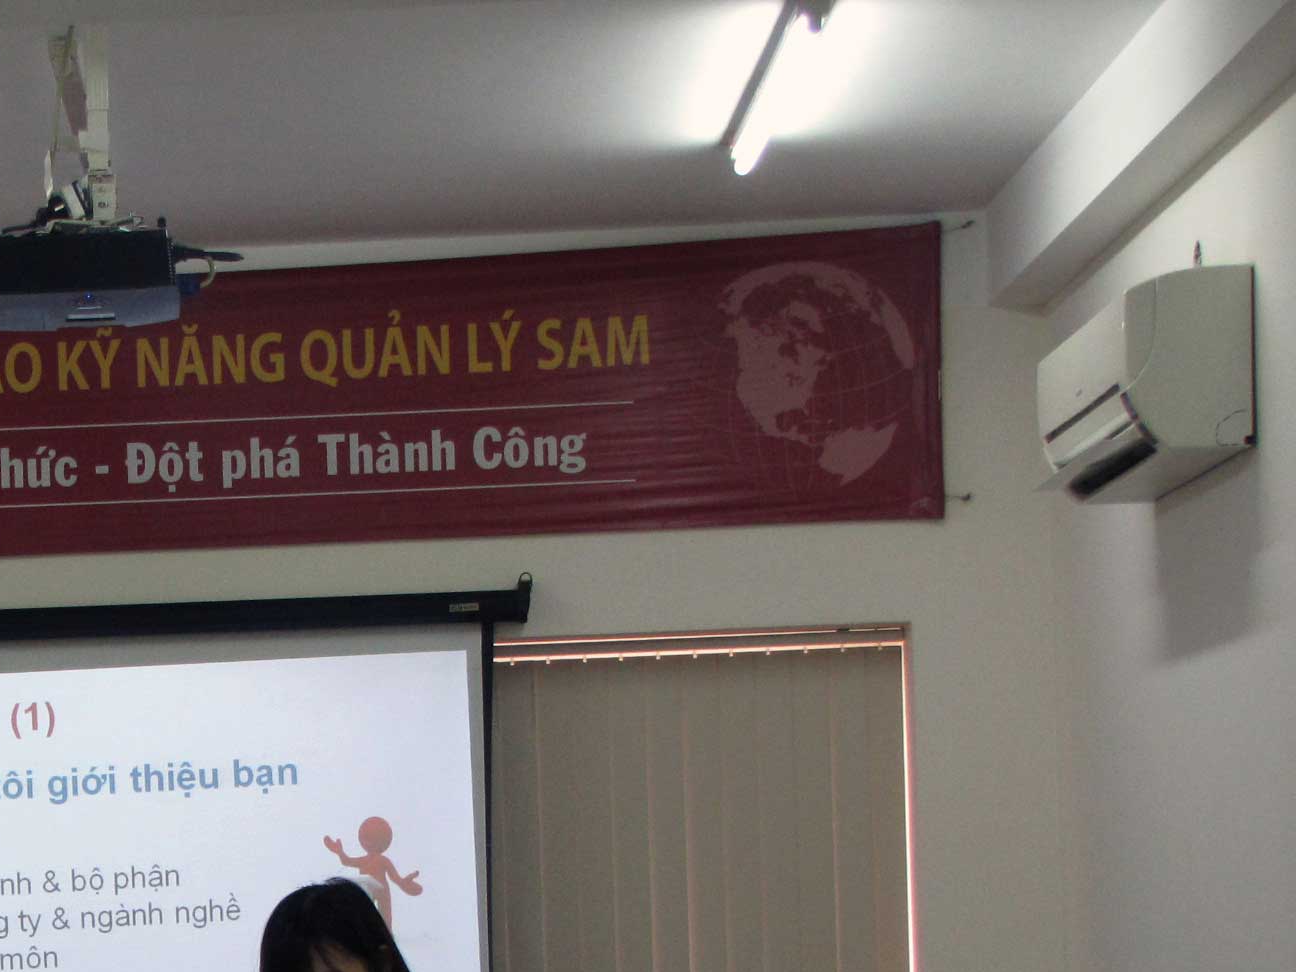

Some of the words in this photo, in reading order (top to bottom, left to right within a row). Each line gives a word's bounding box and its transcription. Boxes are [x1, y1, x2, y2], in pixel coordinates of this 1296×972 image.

[57, 327, 121, 392] KỸ
[135, 321, 285, 388] NĂNG
[300, 310, 450, 387] QUẢN
[466, 309, 521, 373] LÝ
[536, 315, 649, 370] SAM
[125, 441, 204, 493] Đột
[222, 434, 301, 488] phá
[317, 427, 457, 476] Thành
[473, 426, 587, 474] Công
[10, 701, 56, 739] (1)
[47, 765, 116, 804] giới
[130, 761, 219, 798] thiệu
[232, 758, 299, 794] bạn
[42, 870, 62, 893] &
[71, 867, 104, 895] bộ
[114, 864, 180, 895] phận
[18, 910, 41, 938] ty
[52, 907, 71, 930] &
[80, 901, 163, 934] ngành
[175, 892, 241, 929] nghề
[0, 946, 59, 971] môn
